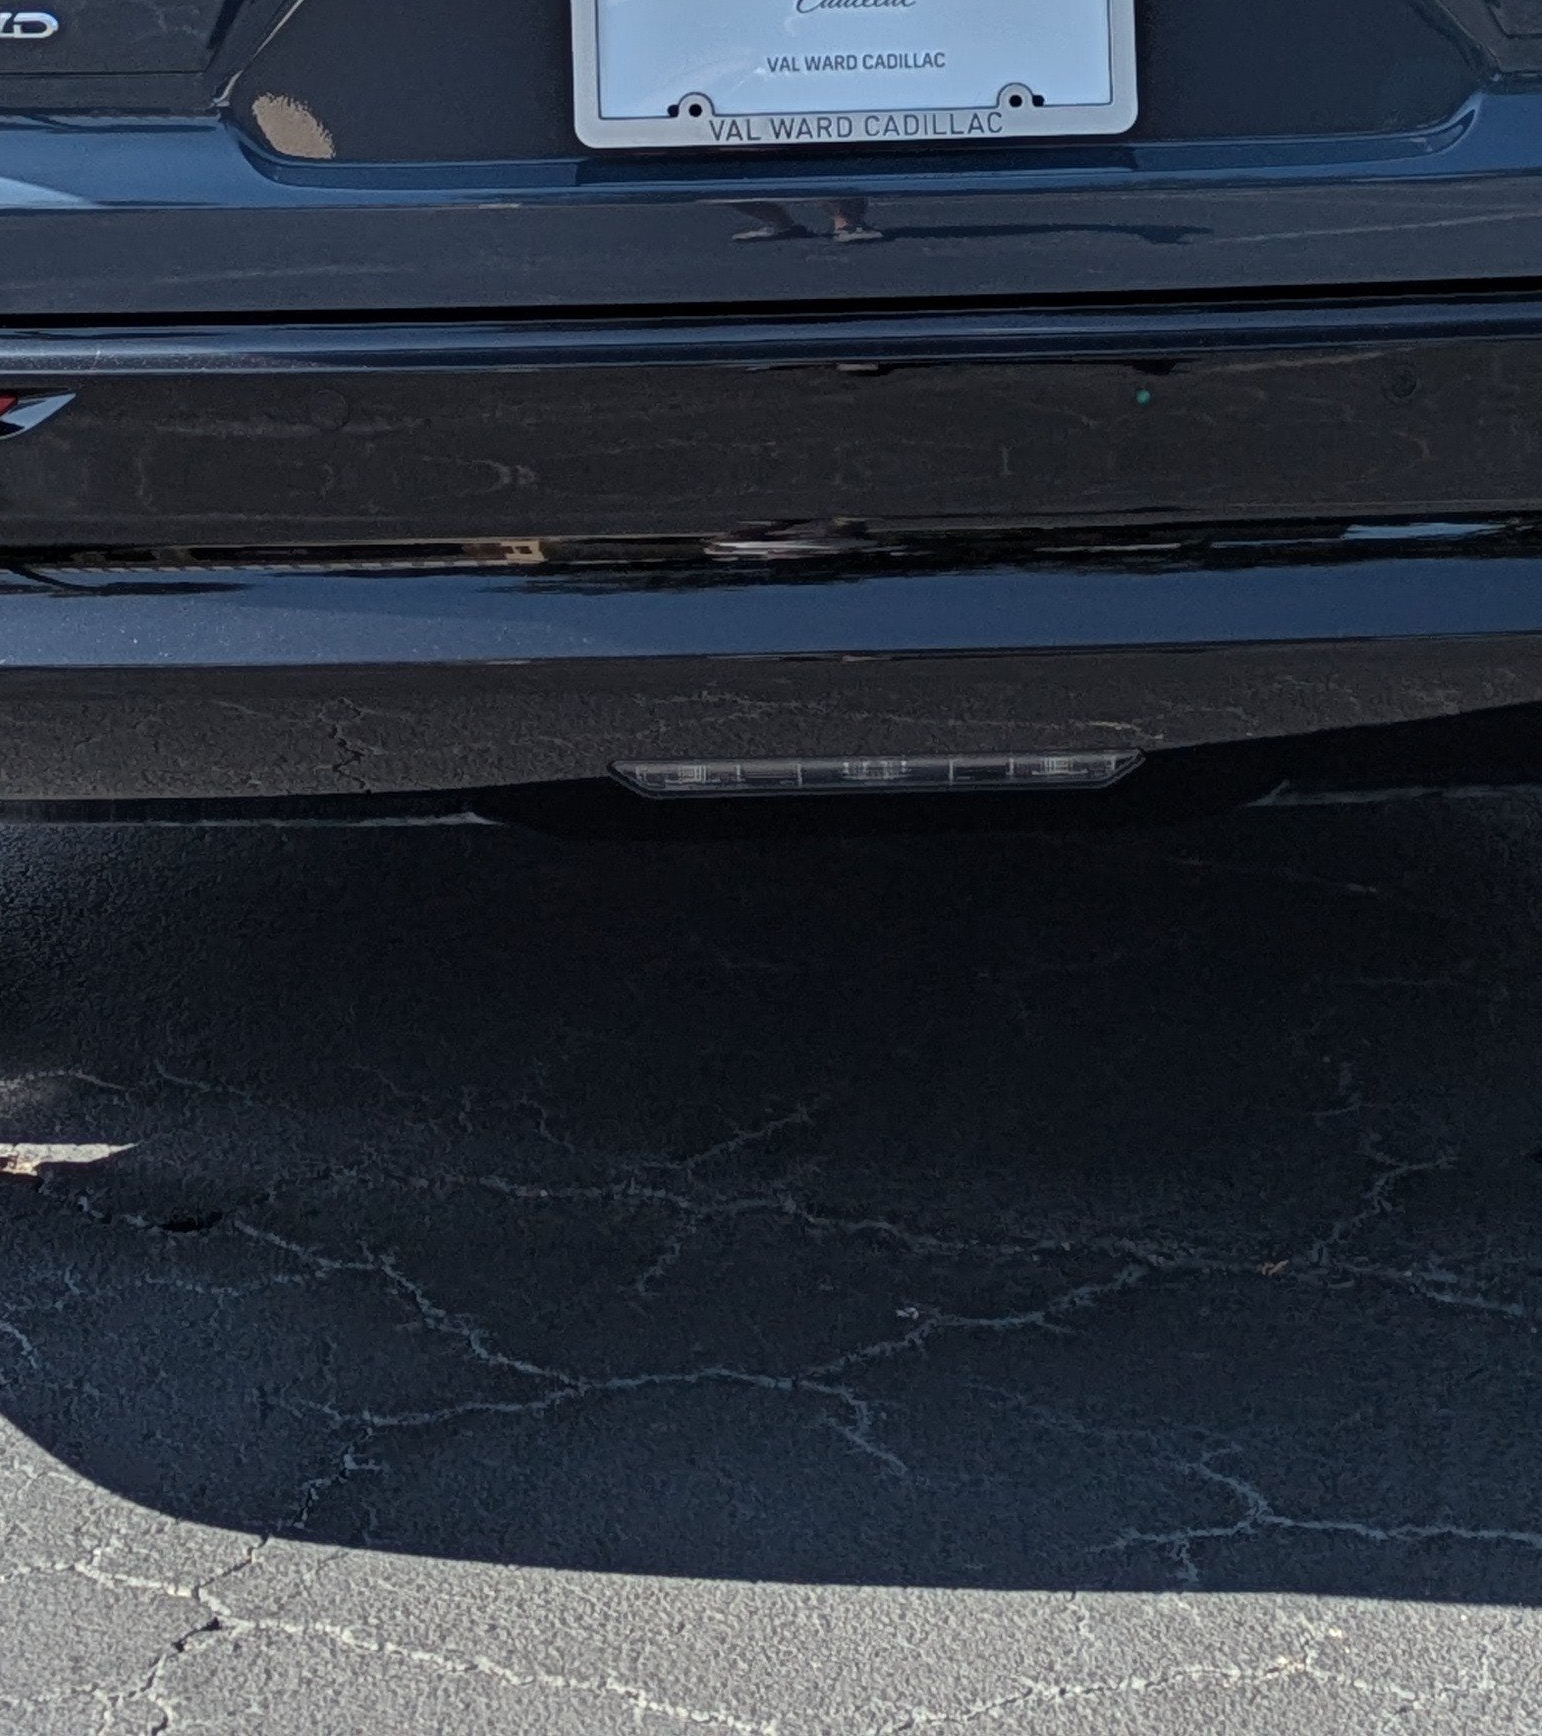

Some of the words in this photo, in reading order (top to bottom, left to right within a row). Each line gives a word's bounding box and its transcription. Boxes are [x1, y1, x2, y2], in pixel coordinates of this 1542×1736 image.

[767, 56, 800, 73] VAL
[805, 54, 858, 71] WARD
[862, 52, 946, 70] CADILLAC
[709, 119, 762, 142] VAL
[771, 116, 853, 140] WARD
[864, 112, 1004, 137] CADILLAC
